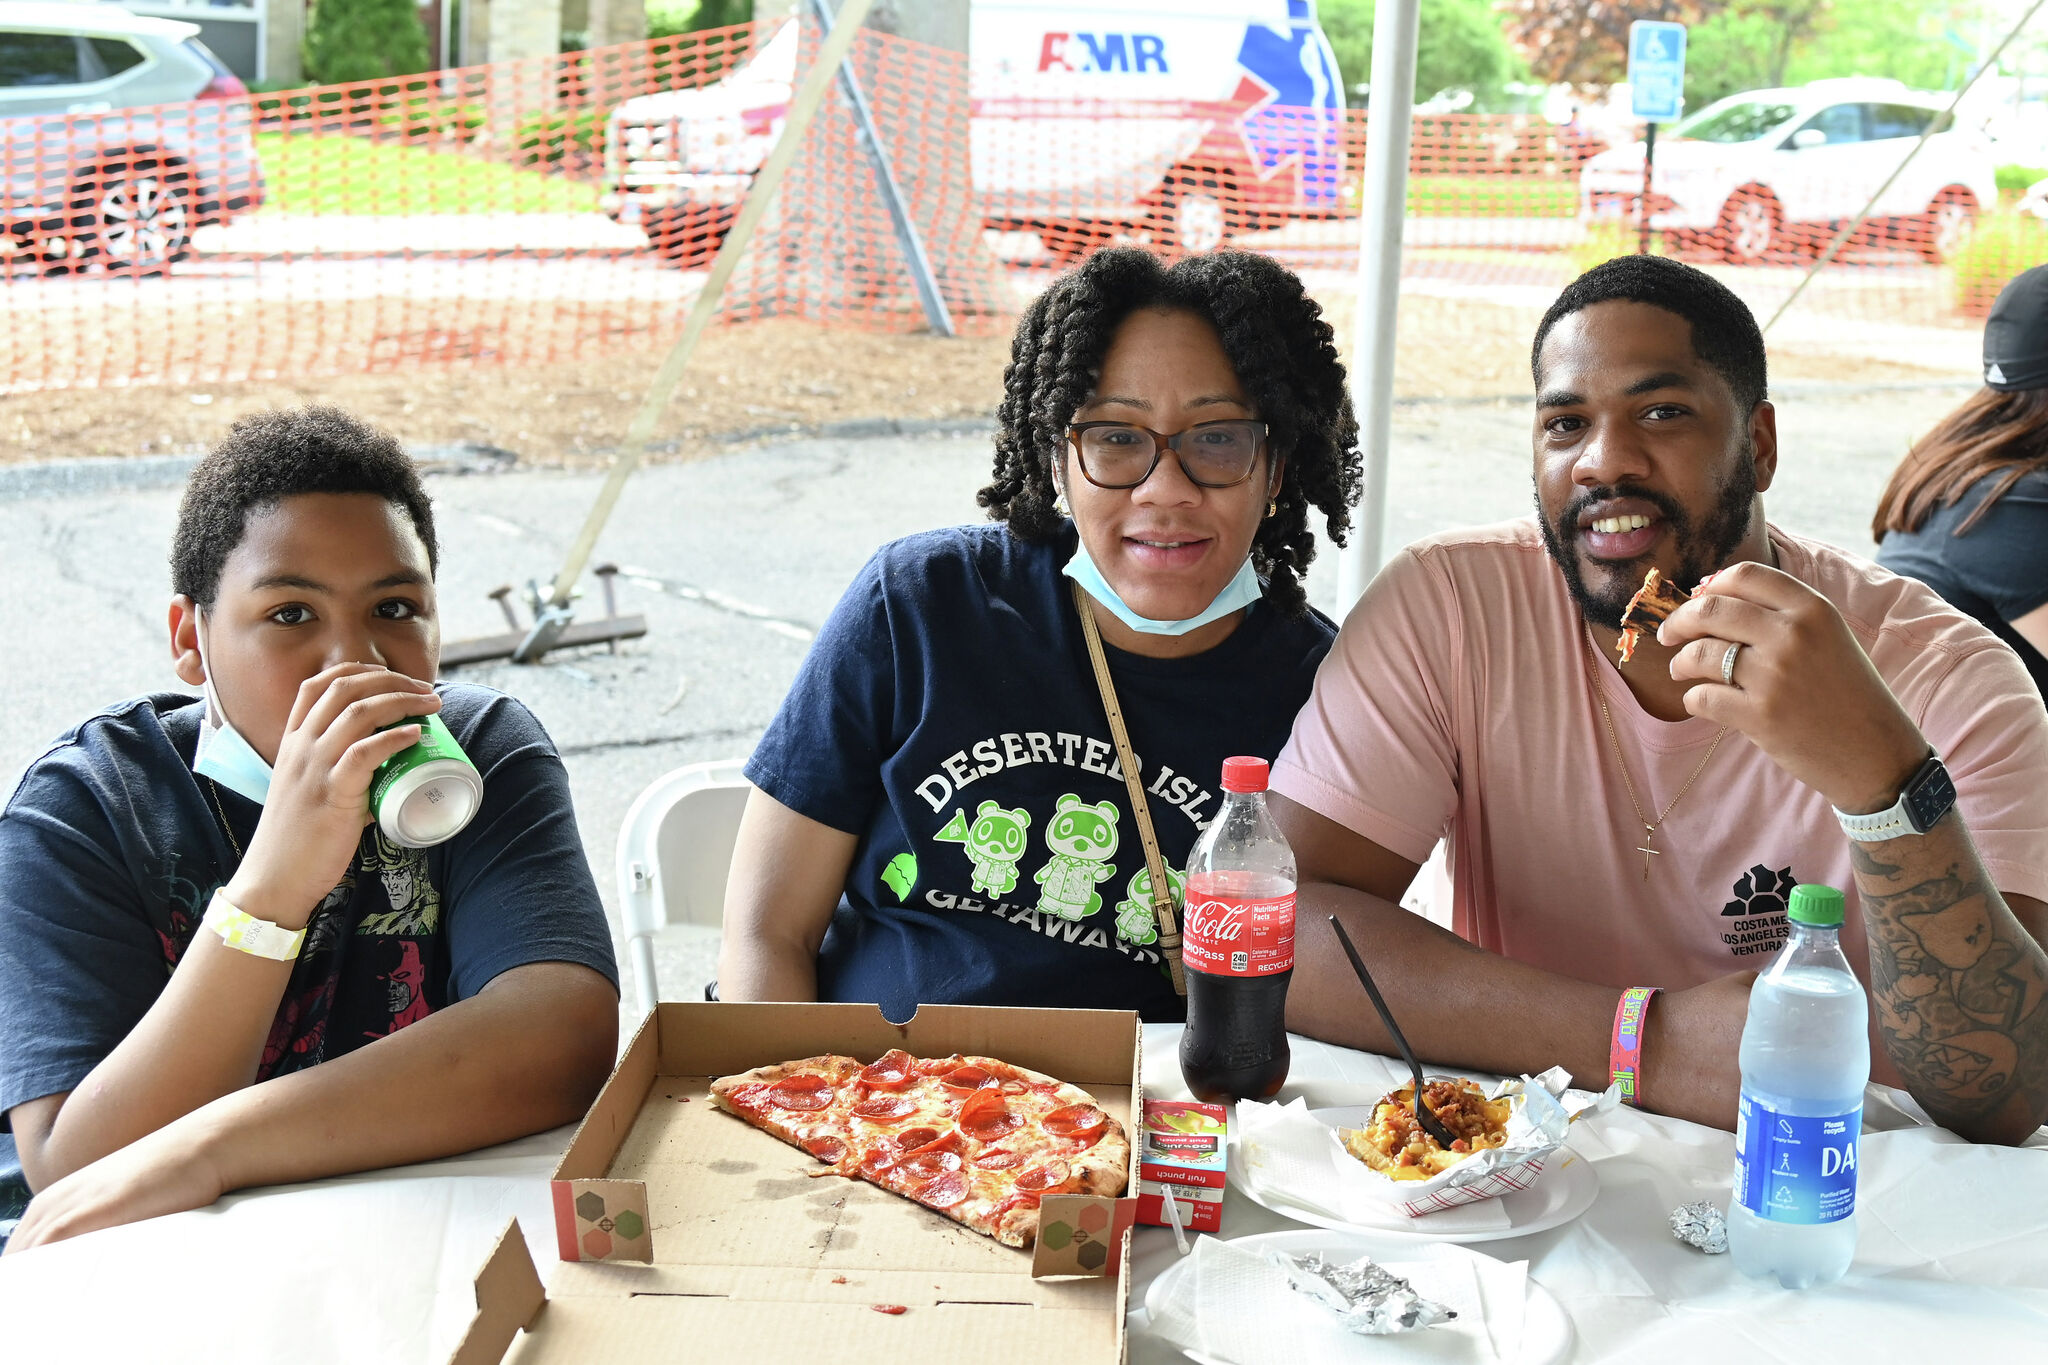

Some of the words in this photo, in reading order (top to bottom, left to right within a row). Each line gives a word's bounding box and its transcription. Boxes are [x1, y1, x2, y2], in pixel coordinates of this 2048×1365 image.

[1147, 765, 1214, 831] ISL
[1253, 904, 1279, 913] Nutrition
[1253, 913, 1270, 921] Facts
[1734, 918, 1769, 931] COSTA
[1770, 915, 1791, 926] ME
[1740, 927, 1790, 944] ANGELES
[1731, 941, 1783, 956] VENTURA
[1232, 953, 1247, 962] 240
[1258, 961, 1289, 973] RECYCLE
[1621, 1001, 1635, 1035] OVER
[1821, 1142, 1858, 1177] DA
[1157, 1171, 1186, 1180] punch
[1188, 1173, 1206, 1183] fruit
